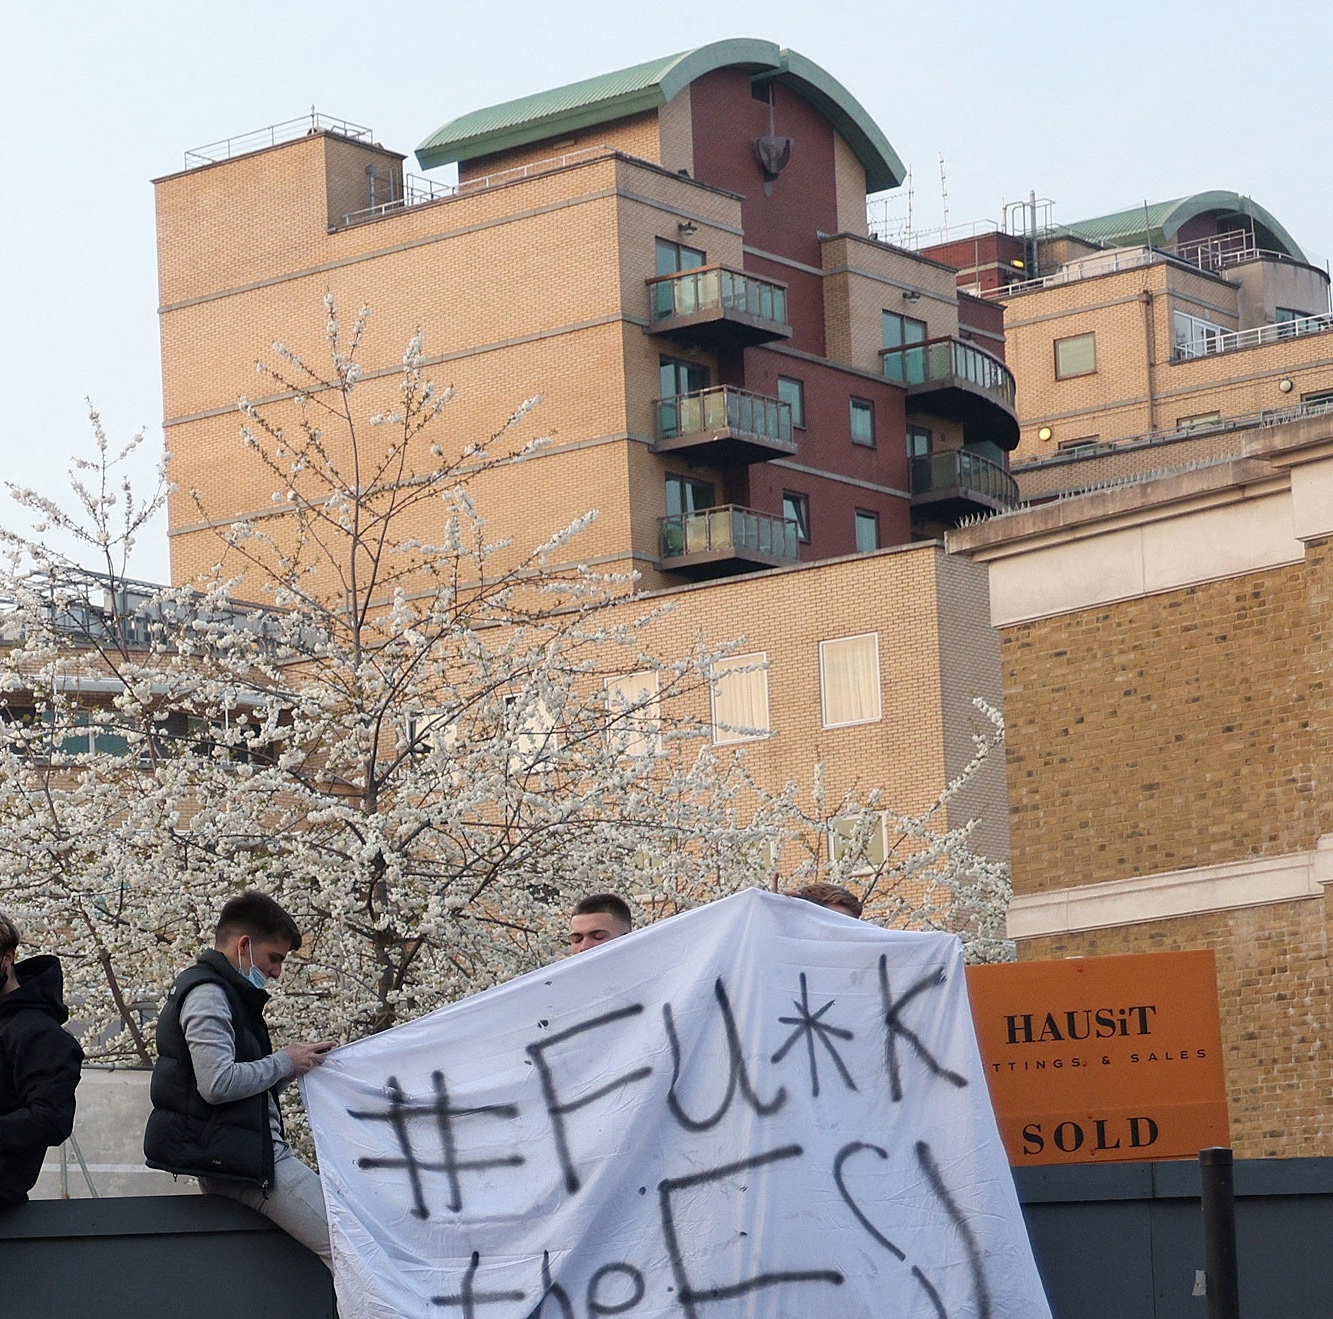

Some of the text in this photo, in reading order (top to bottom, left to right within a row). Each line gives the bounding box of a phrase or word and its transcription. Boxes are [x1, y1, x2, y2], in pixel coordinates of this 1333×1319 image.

[982, 1048, 1207, 1073] TTINGS & SALES
[1022, 1116, 1159, 1156] SOLD
